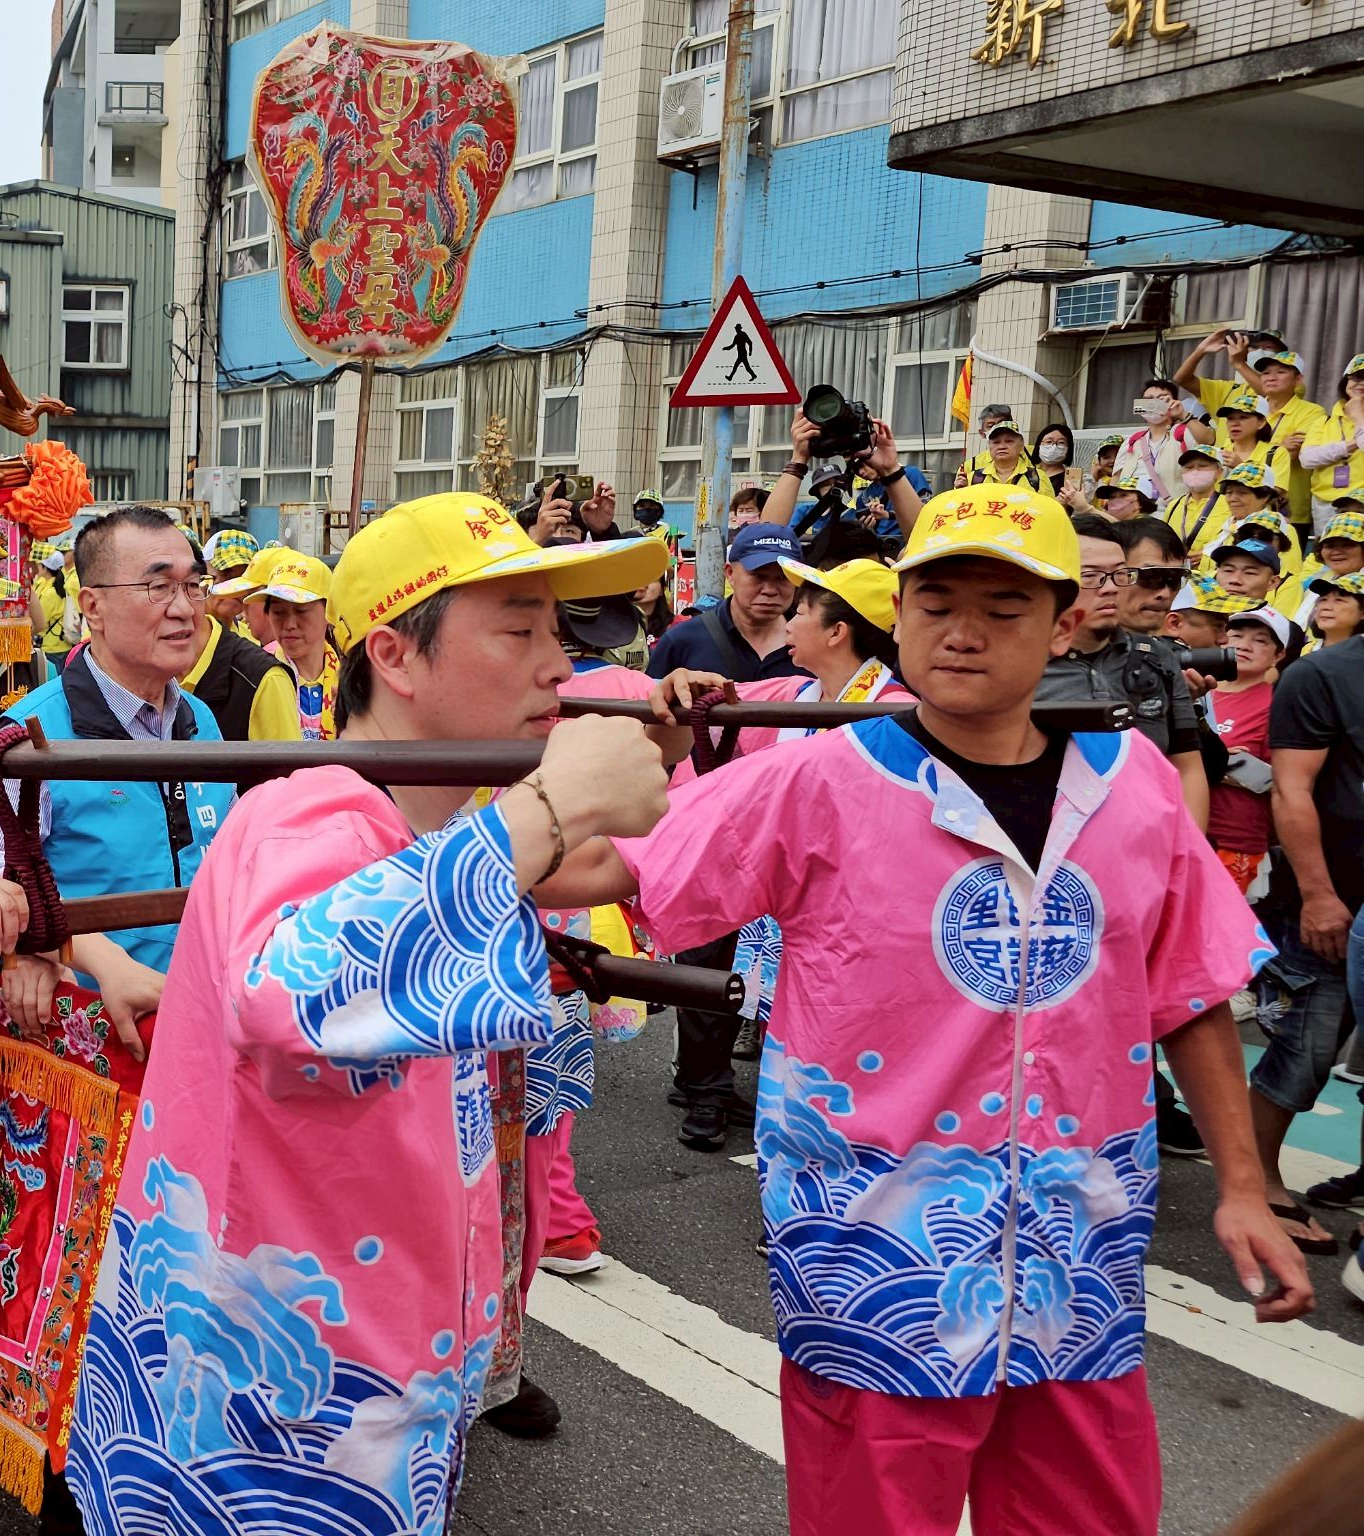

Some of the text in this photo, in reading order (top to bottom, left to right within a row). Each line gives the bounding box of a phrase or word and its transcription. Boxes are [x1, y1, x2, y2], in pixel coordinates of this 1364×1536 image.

[356, 121, 412, 326] 天上聖母
[928, 500, 1036, 531] 金包里媽
